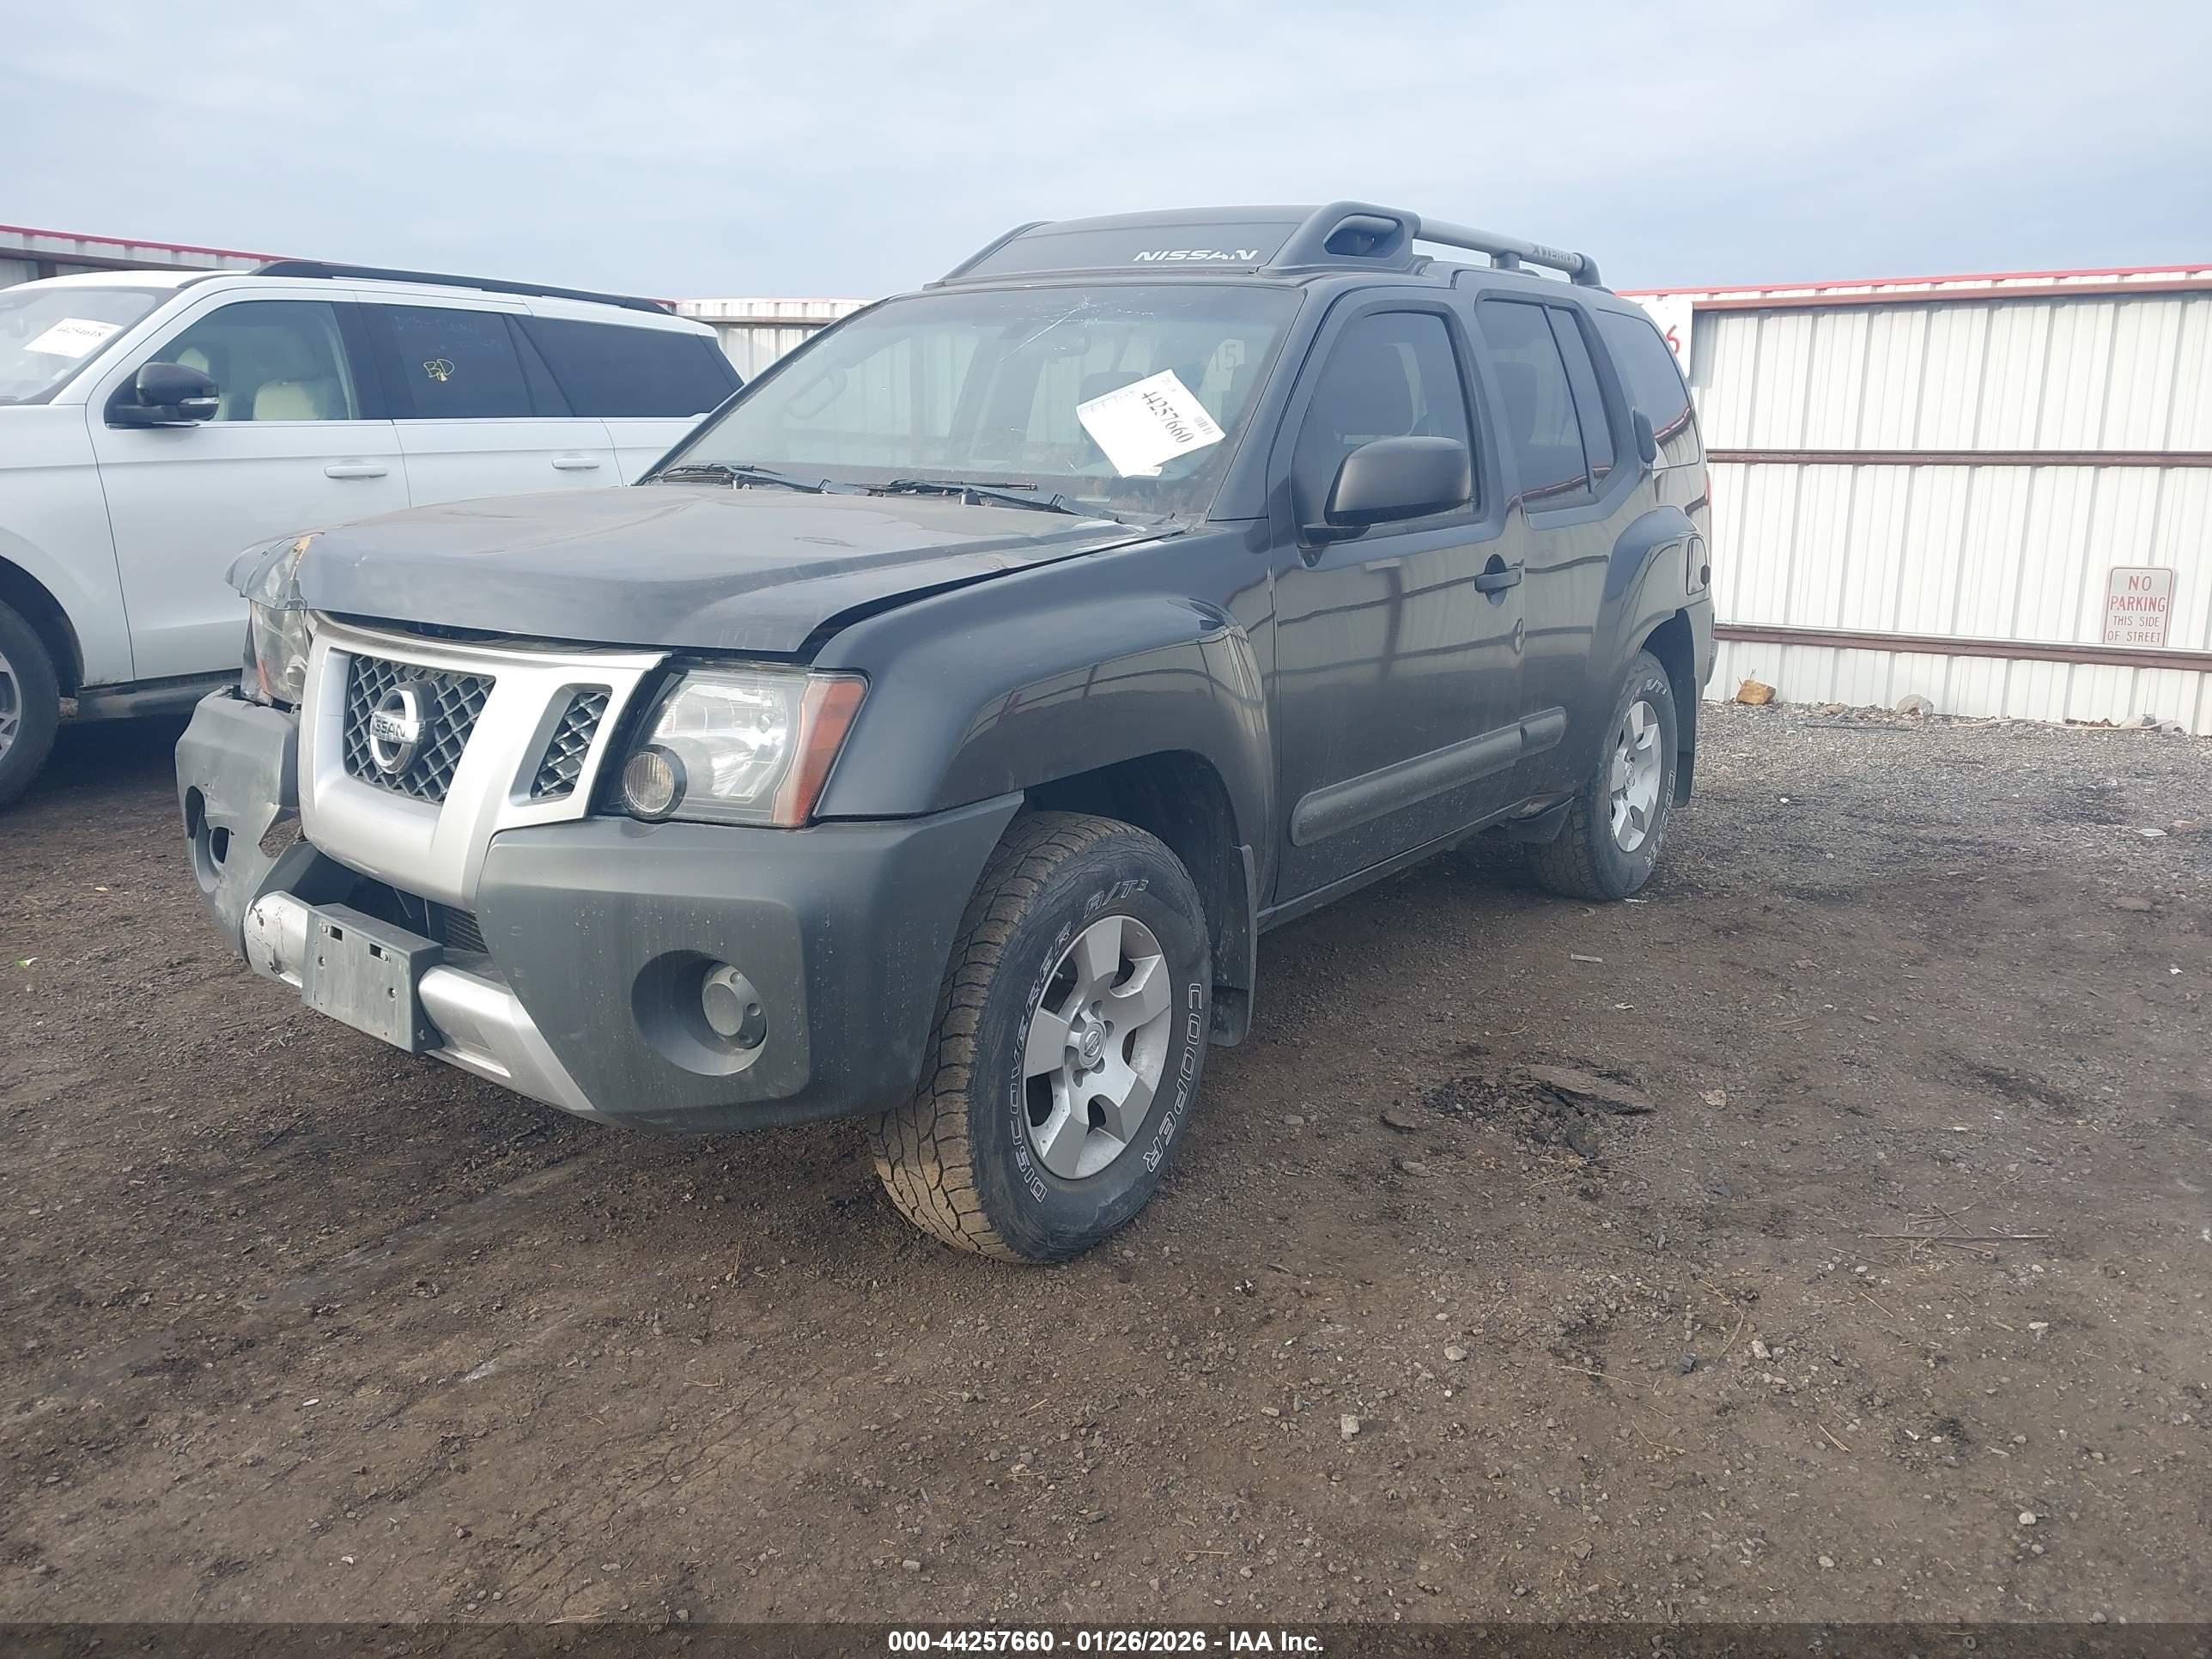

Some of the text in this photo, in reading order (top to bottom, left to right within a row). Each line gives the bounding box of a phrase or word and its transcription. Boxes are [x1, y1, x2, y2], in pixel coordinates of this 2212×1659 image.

[1133, 249, 1259, 262] NISSAN
[1141, 392, 1194, 443] 44257660
[2128, 574, 2152, 592] NO
[2110, 595, 2166, 612] PARKING
[2112, 615, 2160, 627] THIS SIDE
[2106, 629, 2162, 643] OF STREET
[1010, 921, 1073, 1203] DISCOVERER
[1142, 982, 1203, 1173] COOPER
